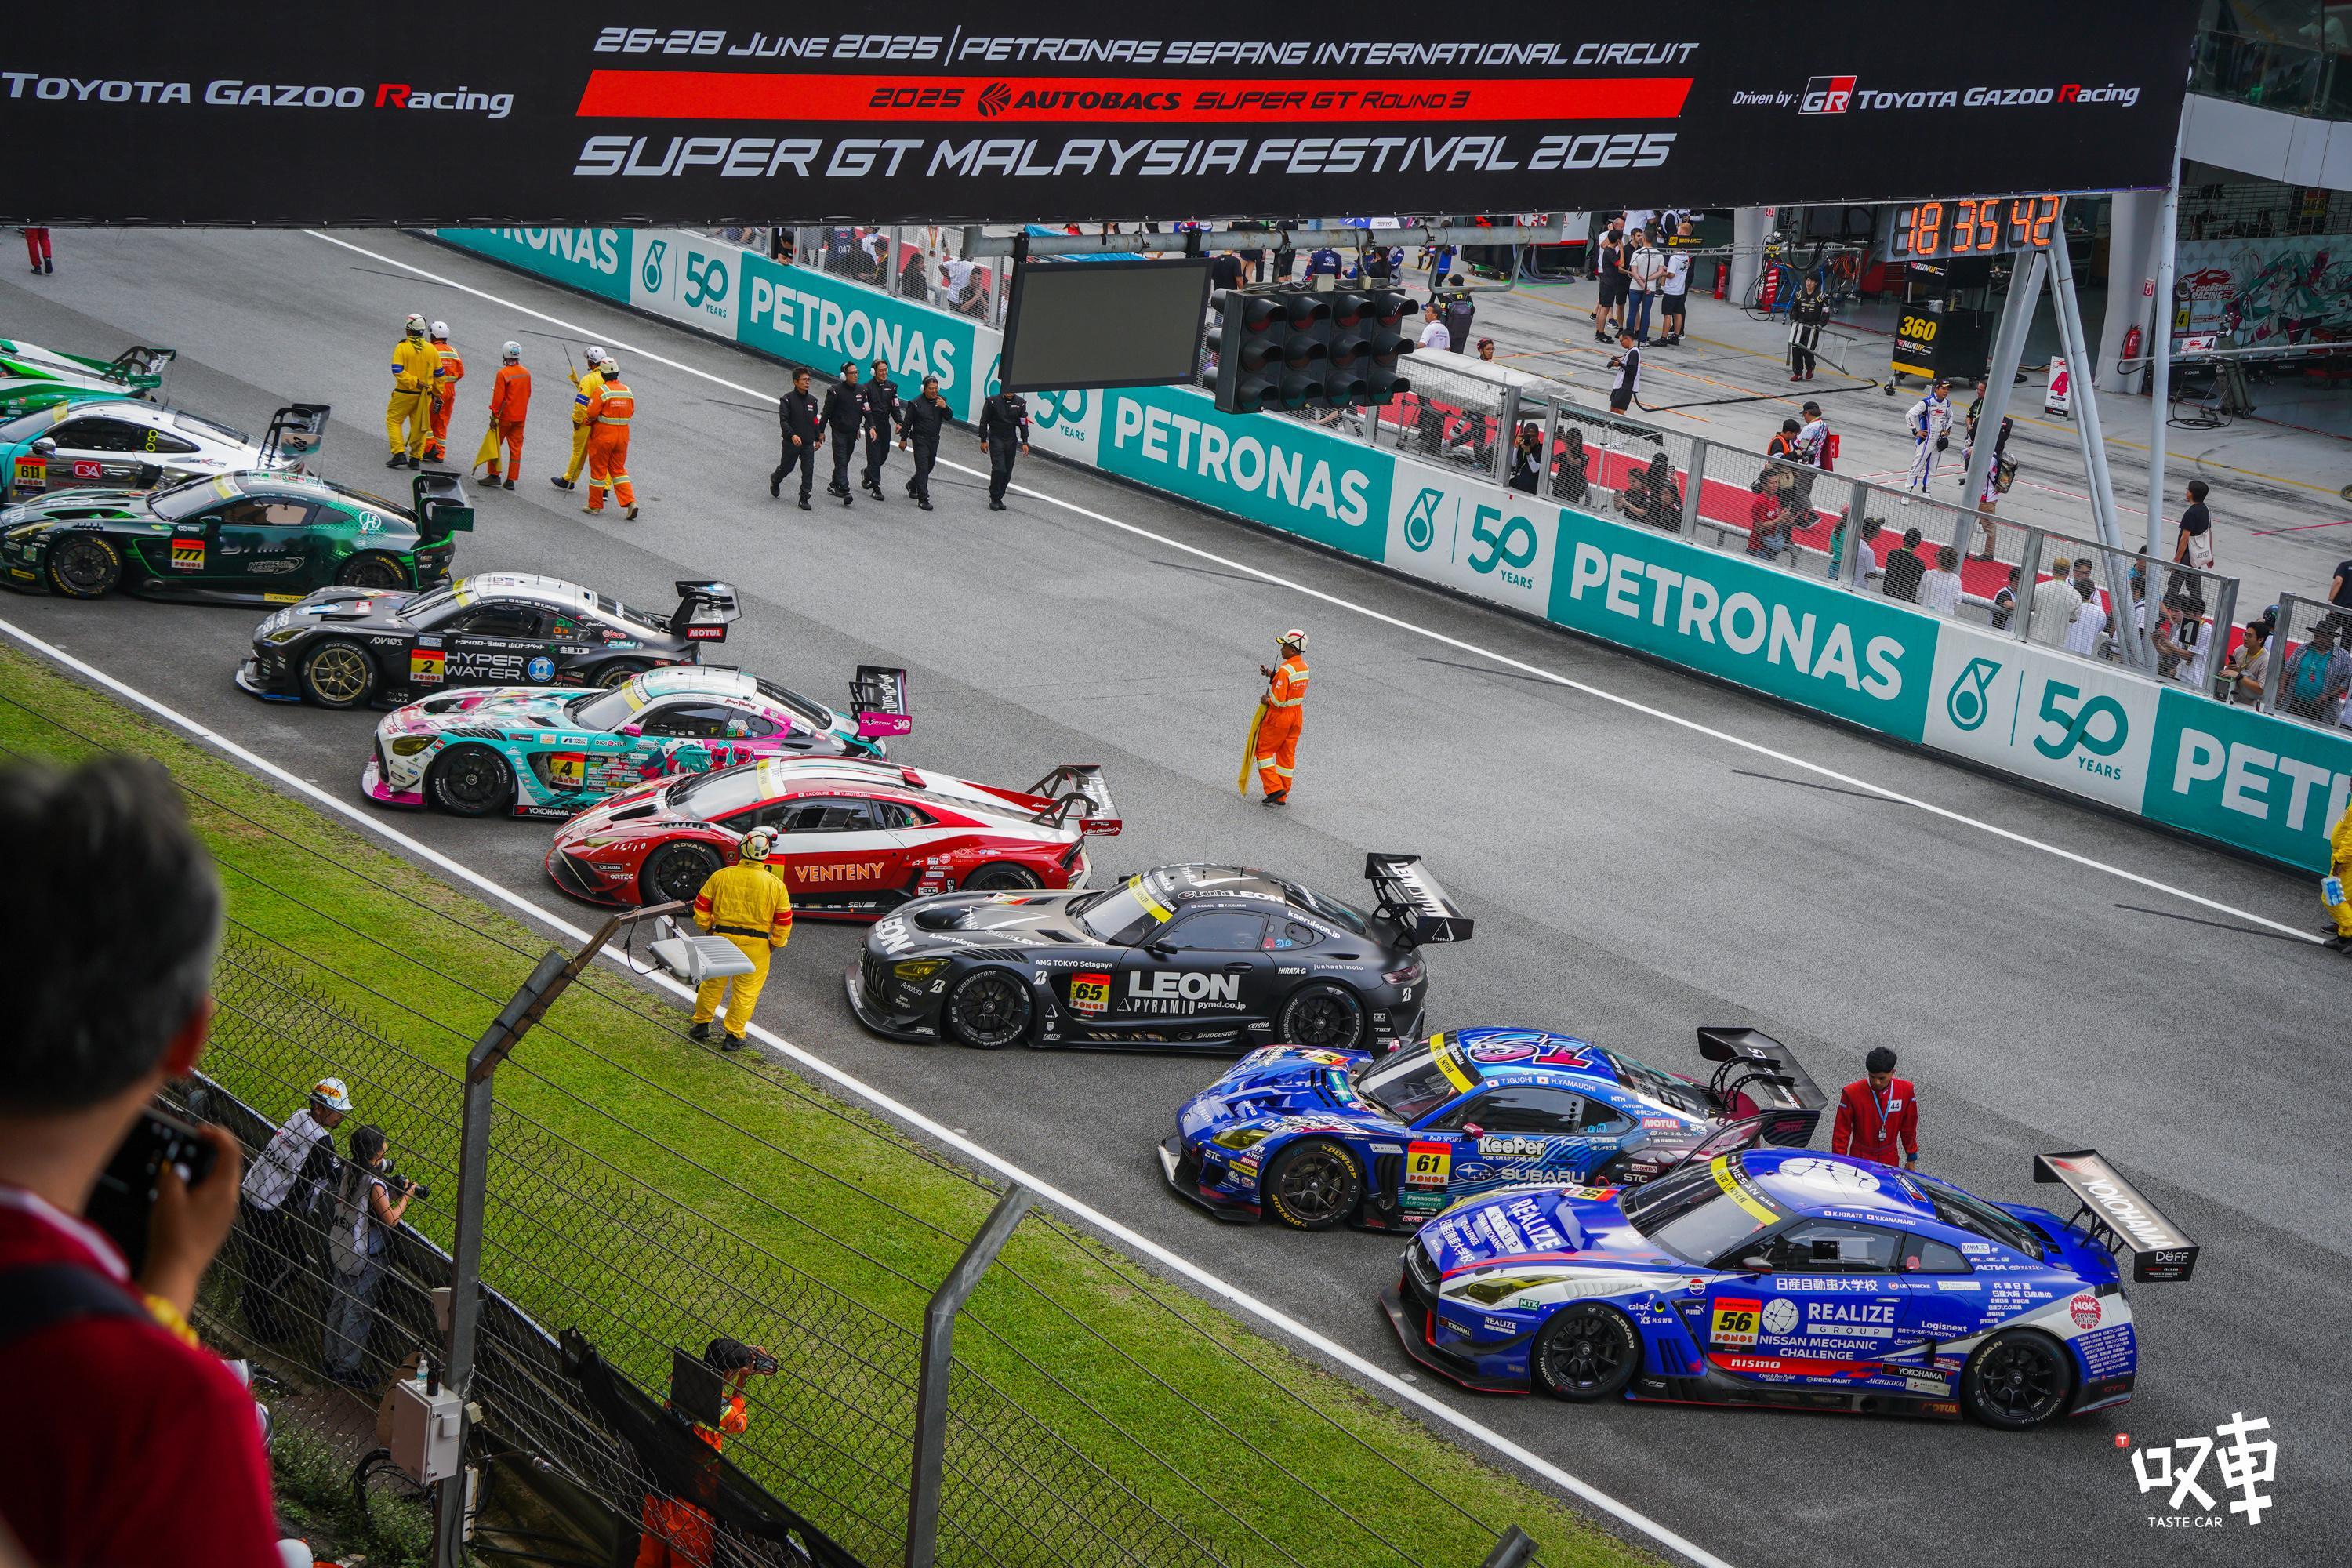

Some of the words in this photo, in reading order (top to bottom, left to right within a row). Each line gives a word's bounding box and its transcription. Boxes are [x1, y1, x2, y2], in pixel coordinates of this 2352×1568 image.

[593, 27, 727, 55] 26-28
[728, 32, 829, 57] JUNE
[832, 34, 943, 60] 2025
[959, 38, 1164, 63] PETRONAS
[1163, 41, 1311, 64] SEPANG
[1313, 42, 1568, 64] INTERNATIONAL
[1573, 42, 1700, 64] CIRCUIT
[2, 72, 191, 103] TOYOTA
[205, 80, 365, 107] GAZOO
[374, 83, 514, 118] Racing
[869, 88, 965, 107] 2025
[1014, 90, 1181, 111] AUTOBACS
[1192, 91, 1308, 110] SUPER
[1310, 91, 1358, 109] GT
[1360, 91, 1448, 109] ROUND
[1449, 90, 1471, 109] 3
[1733, 90, 1773, 105] Driven
[1802, 89, 1852, 112] GR
[1857, 89, 1958, 109] TOYOTA
[1963, 86, 2054, 107] GAZOO
[2057, 82, 2140, 107] Racing
[573, 136, 822, 176] SUPER
[825, 138, 924, 176] GT
[926, 138, 1248, 176] MALAYSIA
[1249, 135, 1519, 175] FESTIVAL
[1527, 133, 1677, 170] 2025
[1907, 202, 1944, 255] 18
[1951, 199, 2002, 252] 35
[2010, 194, 2060, 246] 42
[684, 250, 729, 308] 50
[706, 303, 728, 320] YEARS
[750, 277, 956, 390] PETRONAS
[1900, 315, 1937, 341] 360
[2050, 371, 2069, 397] 4
[1059, 424, 1087, 443] YEARS
[20, 465, 40, 478] 611
[1113, 396, 1370, 527] PETRONAS
[1467, 502, 1537, 575] 50
[96, 540, 118, 567] DUNLOP
[173, 548, 202, 561] 777
[379, 558, 403, 580] DUNLOP
[1500, 569, 1534, 590] YEARS
[1569, 541, 1906, 702] PETRONAS
[688, 627, 721, 637] MOTUL
[2183, 621, 2195, 643] 1
[325, 643, 363, 655] POTENZA
[421, 659, 434, 673] 2
[445, 652, 524, 667] HYPER
[2033, 678, 2129, 760] 50
[559, 761, 574, 776] 4
[2078, 755, 2122, 781] YEARS
[551, 775, 581, 785] PONOS
[435, 777, 451, 807] ADVAN
[528, 807, 570, 817] YOKOHAMA
[673, 841, 706, 853] ADVAN
[794, 862, 884, 883] VENTENY
[1287, 909, 1341, 940] kaeruleon.jp
[1080, 960, 1113, 970] Setagaya
[900, 981, 923, 996] Amatora
[957, 970, 997, 993] BRIDGESTONE
[1127, 970, 1240, 1001] LEON
[1076, 982, 1105, 1002] 65
[1073, 1000, 1105, 1011] PONOS
[1134, 998, 1196, 1015] PYRAMID
[1198, 1001, 1247, 1011] pymd.co.jp
[1285, 997, 1299, 1039] BRIDGESTONE
[1197, 1029, 1239, 1039] BRIDGESTONE
[1501, 1076, 1533, 1085] T.IGUCHI
[1551, 1078, 1596, 1093] H.YAMAUCHI
[1644, 1119, 1678, 1129] MOTUL
[1479, 1135, 1547, 1156] KeePer
[1204, 1149, 1221, 1163] STC
[1241, 1156, 1258, 1167] MOTUL
[1327, 1145, 1358, 1180] DUNLOP
[1415, 1154, 1441, 1174] 61
[1234, 1162, 1256, 1176] DUNLOP
[1410, 1174, 1445, 1184] PONOS
[1501, 1168, 1585, 1183] SUBARU
[1624, 1174, 1649, 1183] STC
[1730, 1165, 1760, 1196] NISSAN
[1406, 1194, 1442, 1203] Panasonic
[1272, 1192, 1304, 1228] DUNLOP
[1832, 1210, 1863, 1219] K.HIRATE
[1875, 1214, 1916, 1226] Y.KANAMARU
[2081, 1178, 2174, 1250] YOKOHAMA
[1460, 1220, 1480, 1247] CHALLENGE
[1489, 1212, 1519, 1248] GROUP
[1509, 1197, 1562, 1252] REALIZE
[1776, 1278, 1879, 1292] 日産自動車大学校
[1520, 1298, 1539, 1308] NTK
[1808, 1302, 1895, 1323] REALIZE
[2073, 1301, 2097, 1311] NGK
[1447, 1321, 1471, 1337] YOKOHAMA
[1484, 1316, 1517, 1330] REALIZE
[1611, 1314, 1635, 1349] ADVAN
[1719, 1312, 1753, 1332] 56
[1820, 1326, 1880, 1336] GROUP
[1922, 1320, 1968, 1333] Logisnext
[1715, 1333, 1753, 1343] PONOS
[1759, 1336, 1807, 1347] NISSAN
[1809, 1338, 1878, 1351] MECHANIC
[1731, 1358, 1781, 1370] nismo
[1780, 1348, 1854, 1361] CHALLENGE
[1974, 1340, 2003, 1374] ADVAN
[1539, 1356, 1556, 1387] YOKOHAMA
[1898, 1367, 1943, 1381] YOKOHAMA
